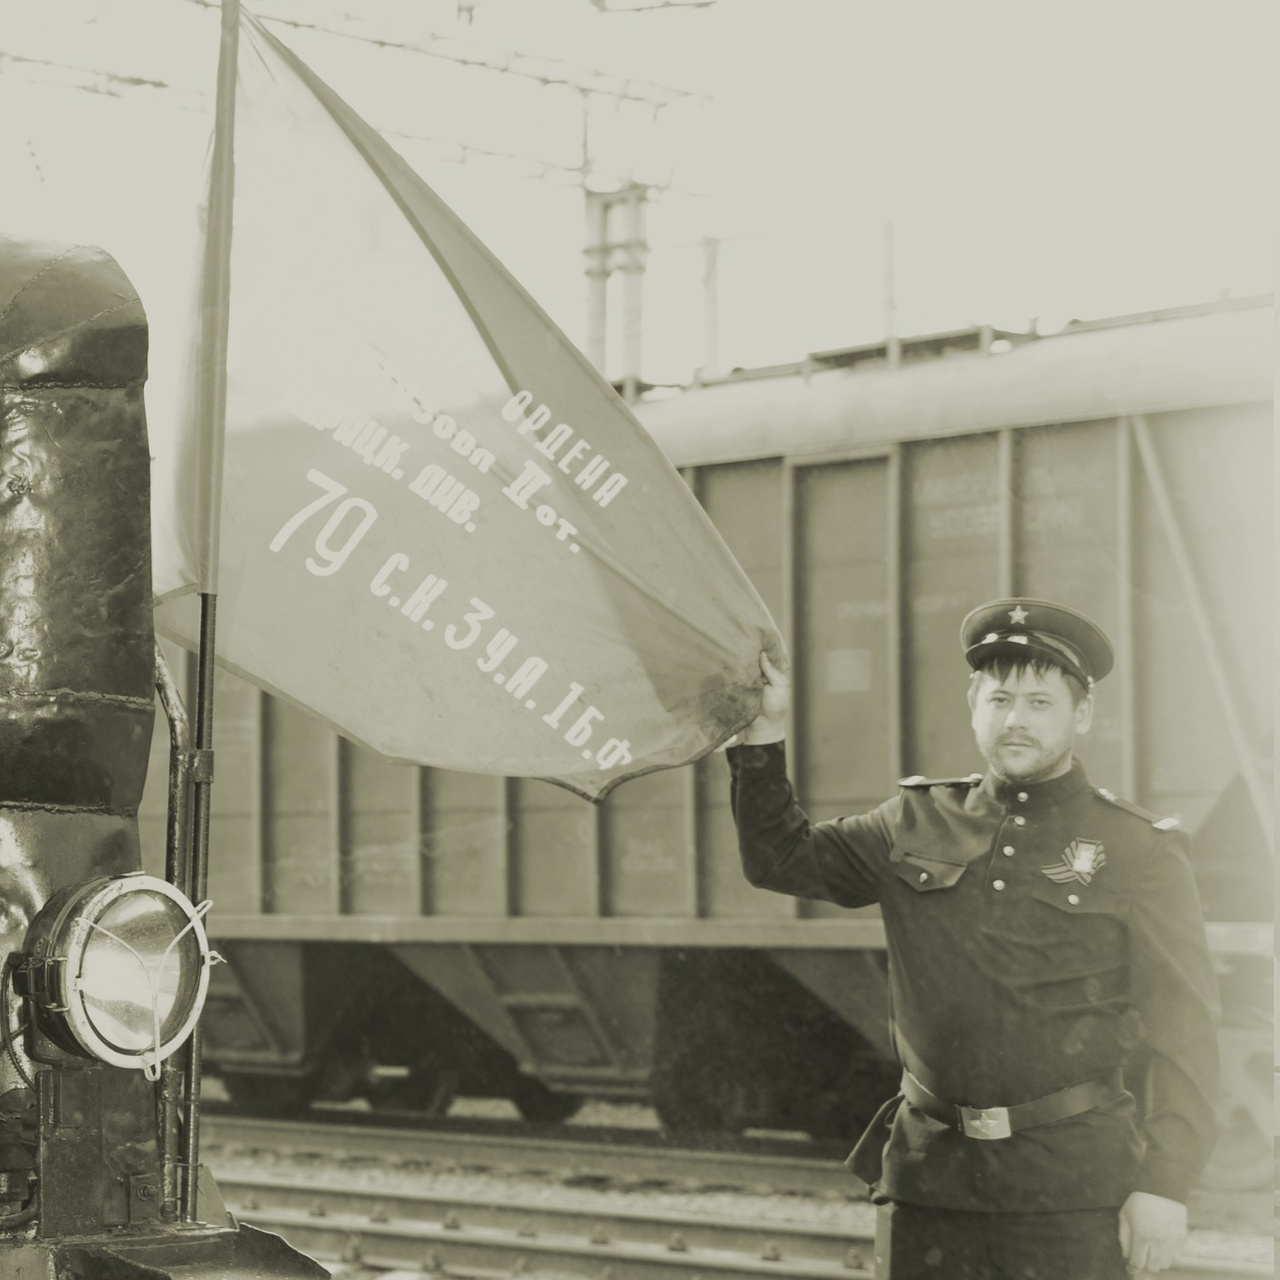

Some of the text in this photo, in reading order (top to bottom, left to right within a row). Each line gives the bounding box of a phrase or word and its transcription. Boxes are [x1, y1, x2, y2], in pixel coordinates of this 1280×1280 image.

[408, 463, 480, 533] ДИВ.
[501, 390, 629, 508] ОРДЕНА
[269, 468, 378, 577] 79
